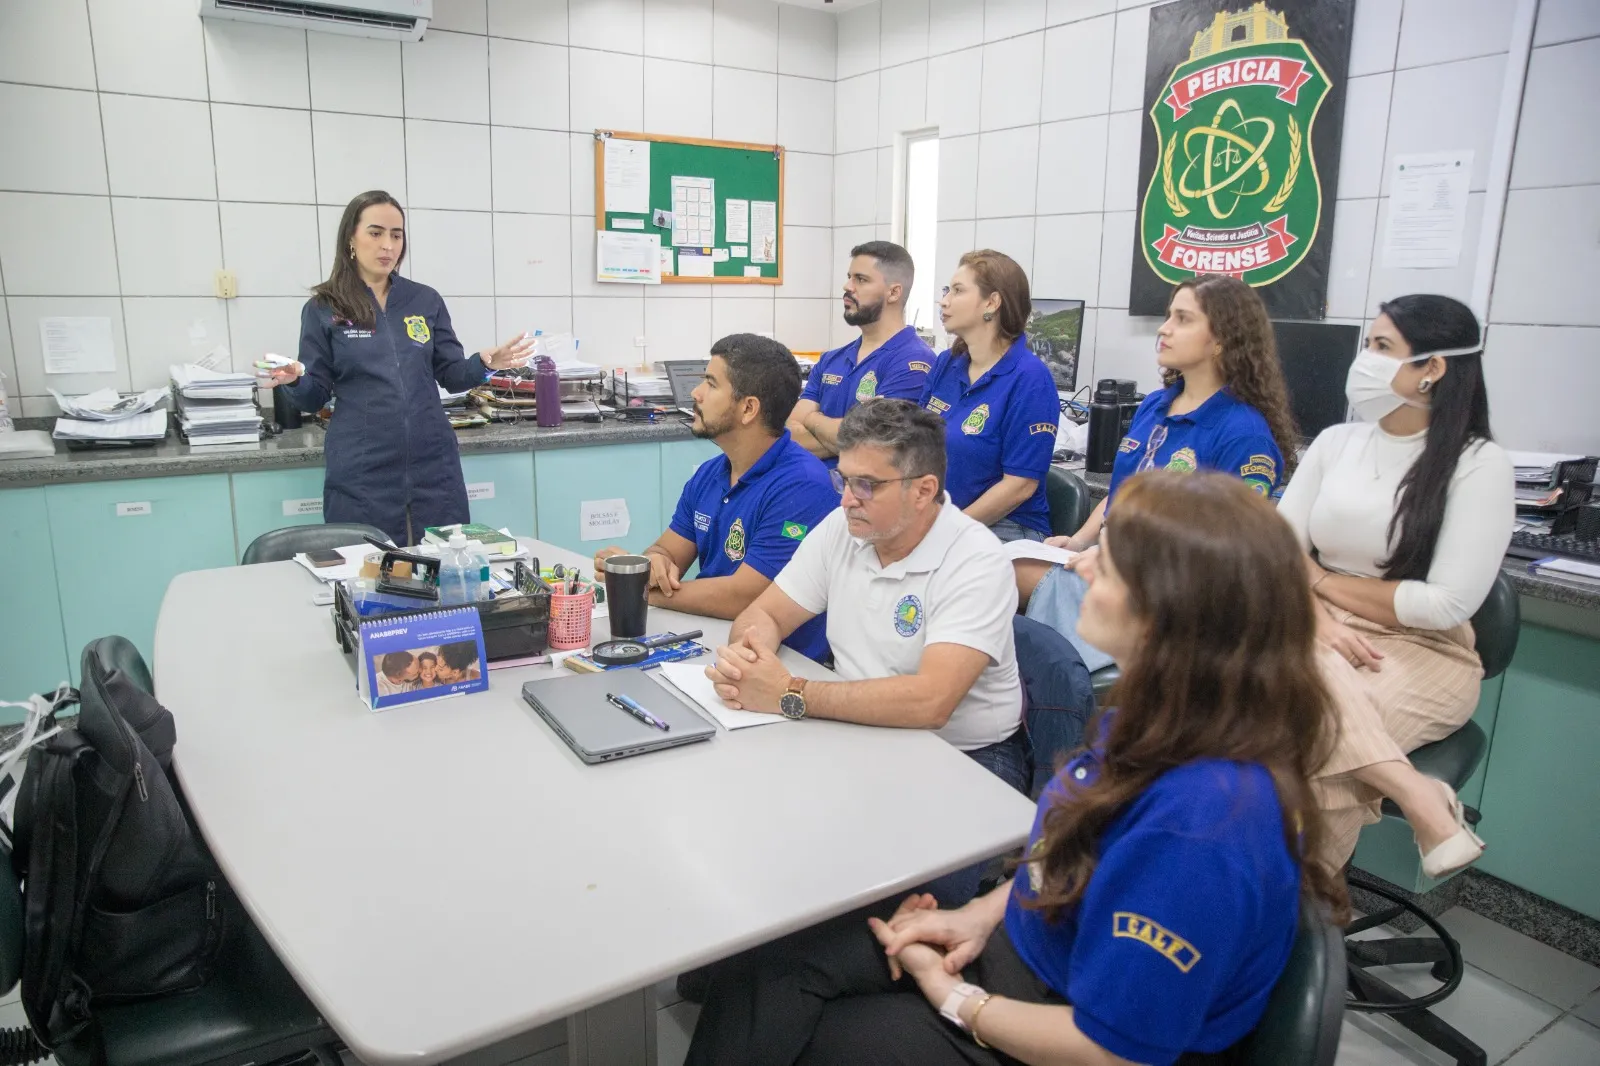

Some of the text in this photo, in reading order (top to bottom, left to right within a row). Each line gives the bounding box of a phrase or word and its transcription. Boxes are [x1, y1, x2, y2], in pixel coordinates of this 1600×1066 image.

[1187, 60, 1281, 98] PERÍCIA
[1230, 232, 1237, 241] et
[1170, 242, 1271, 271] FORENSE
[1127, 916, 1184, 957] CALF
